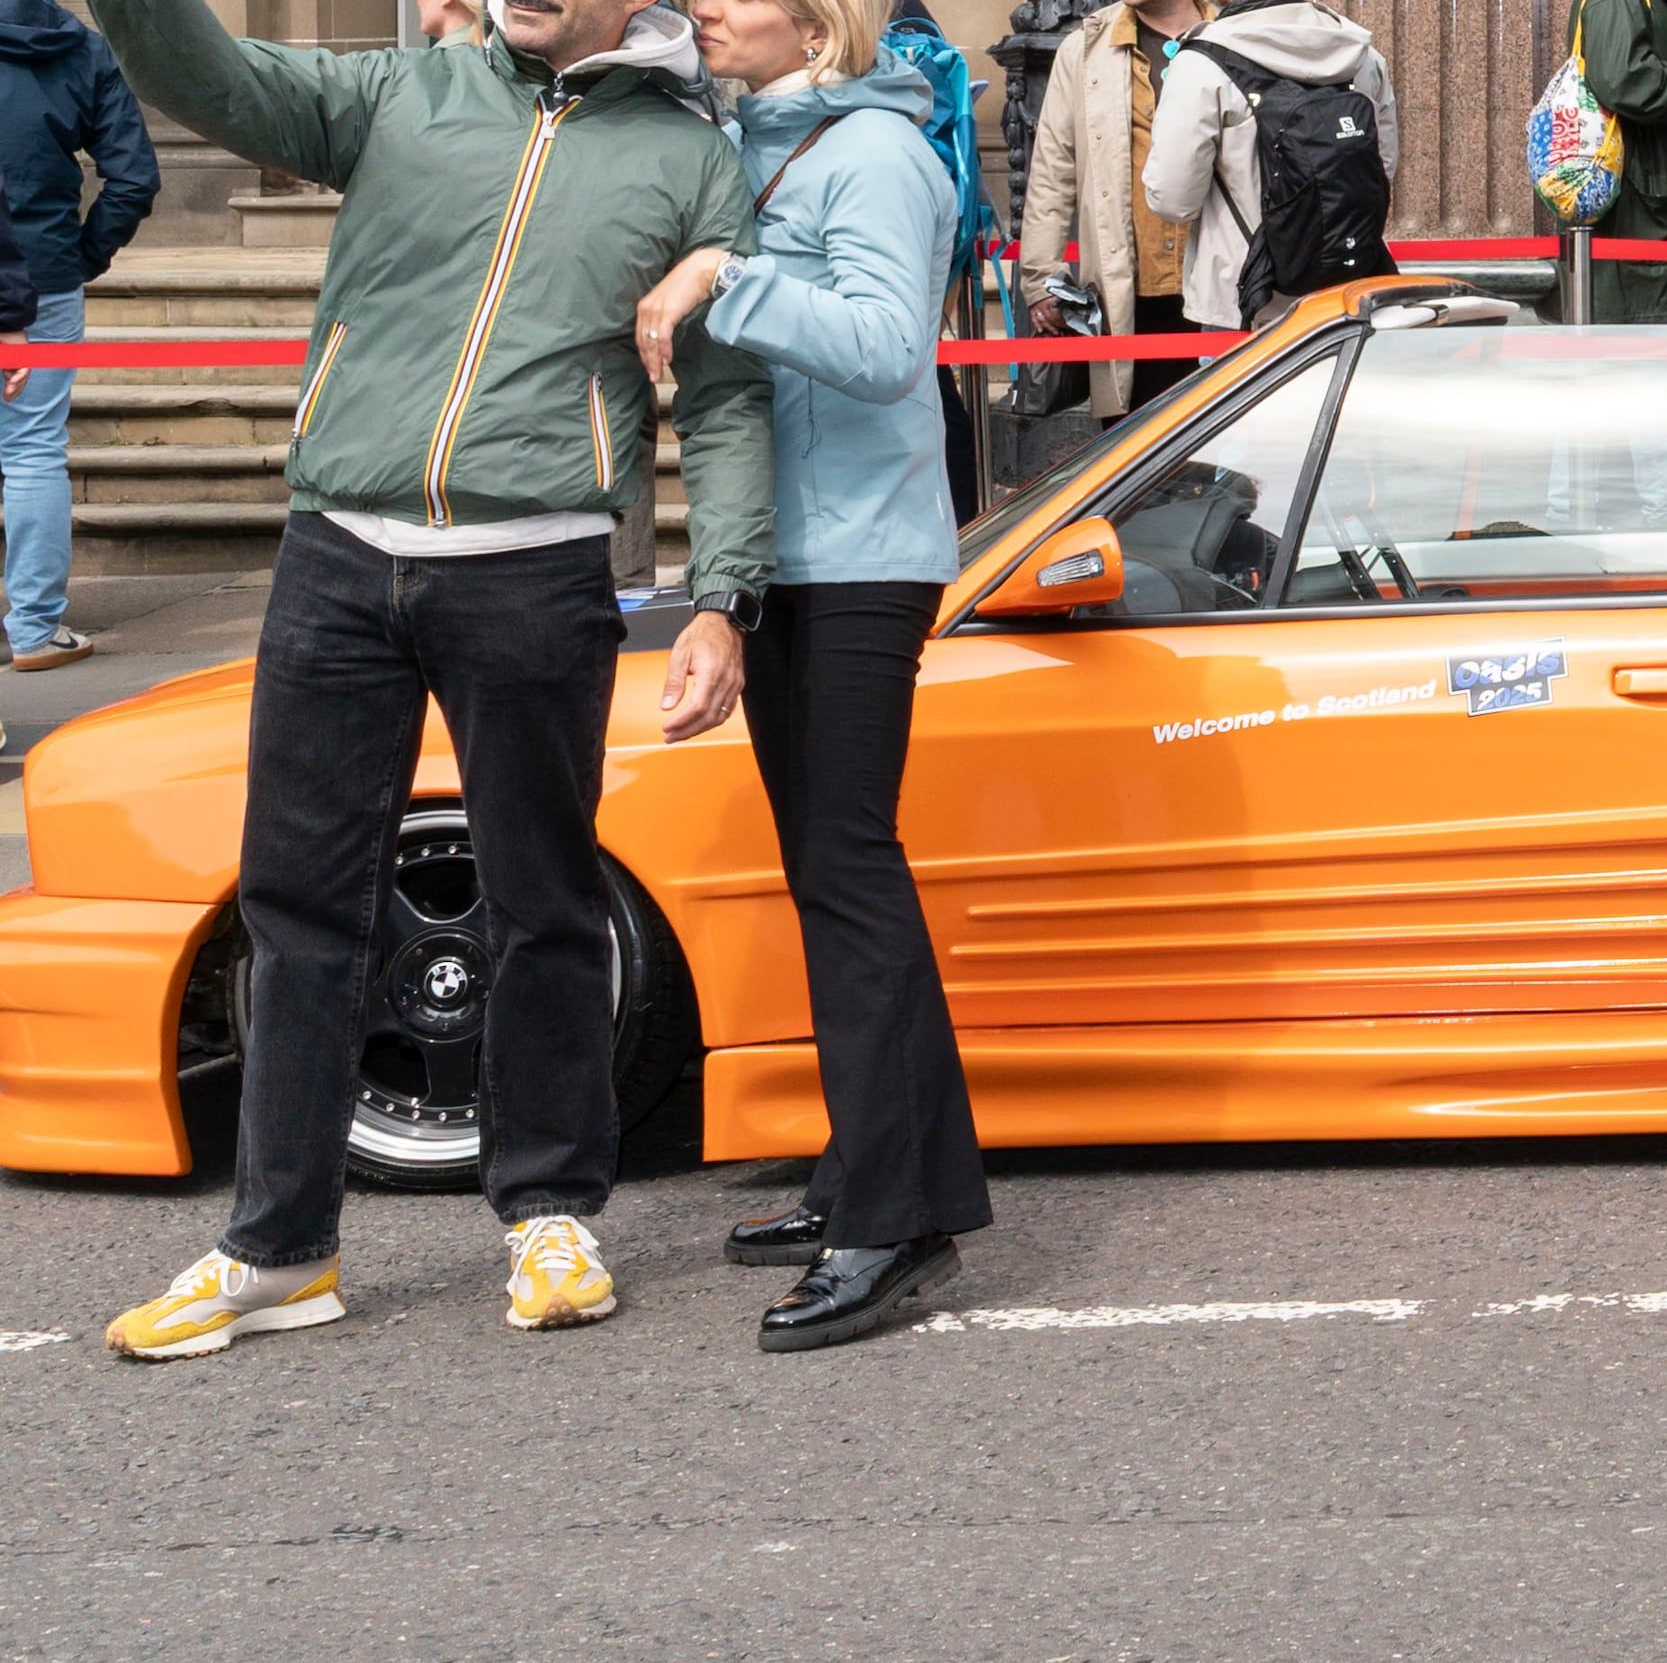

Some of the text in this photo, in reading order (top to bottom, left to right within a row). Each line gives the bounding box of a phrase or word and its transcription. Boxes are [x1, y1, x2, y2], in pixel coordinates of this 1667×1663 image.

[1152, 679, 1438, 744] Welcome to Scotland
[1477, 681, 1542, 711] 2025
